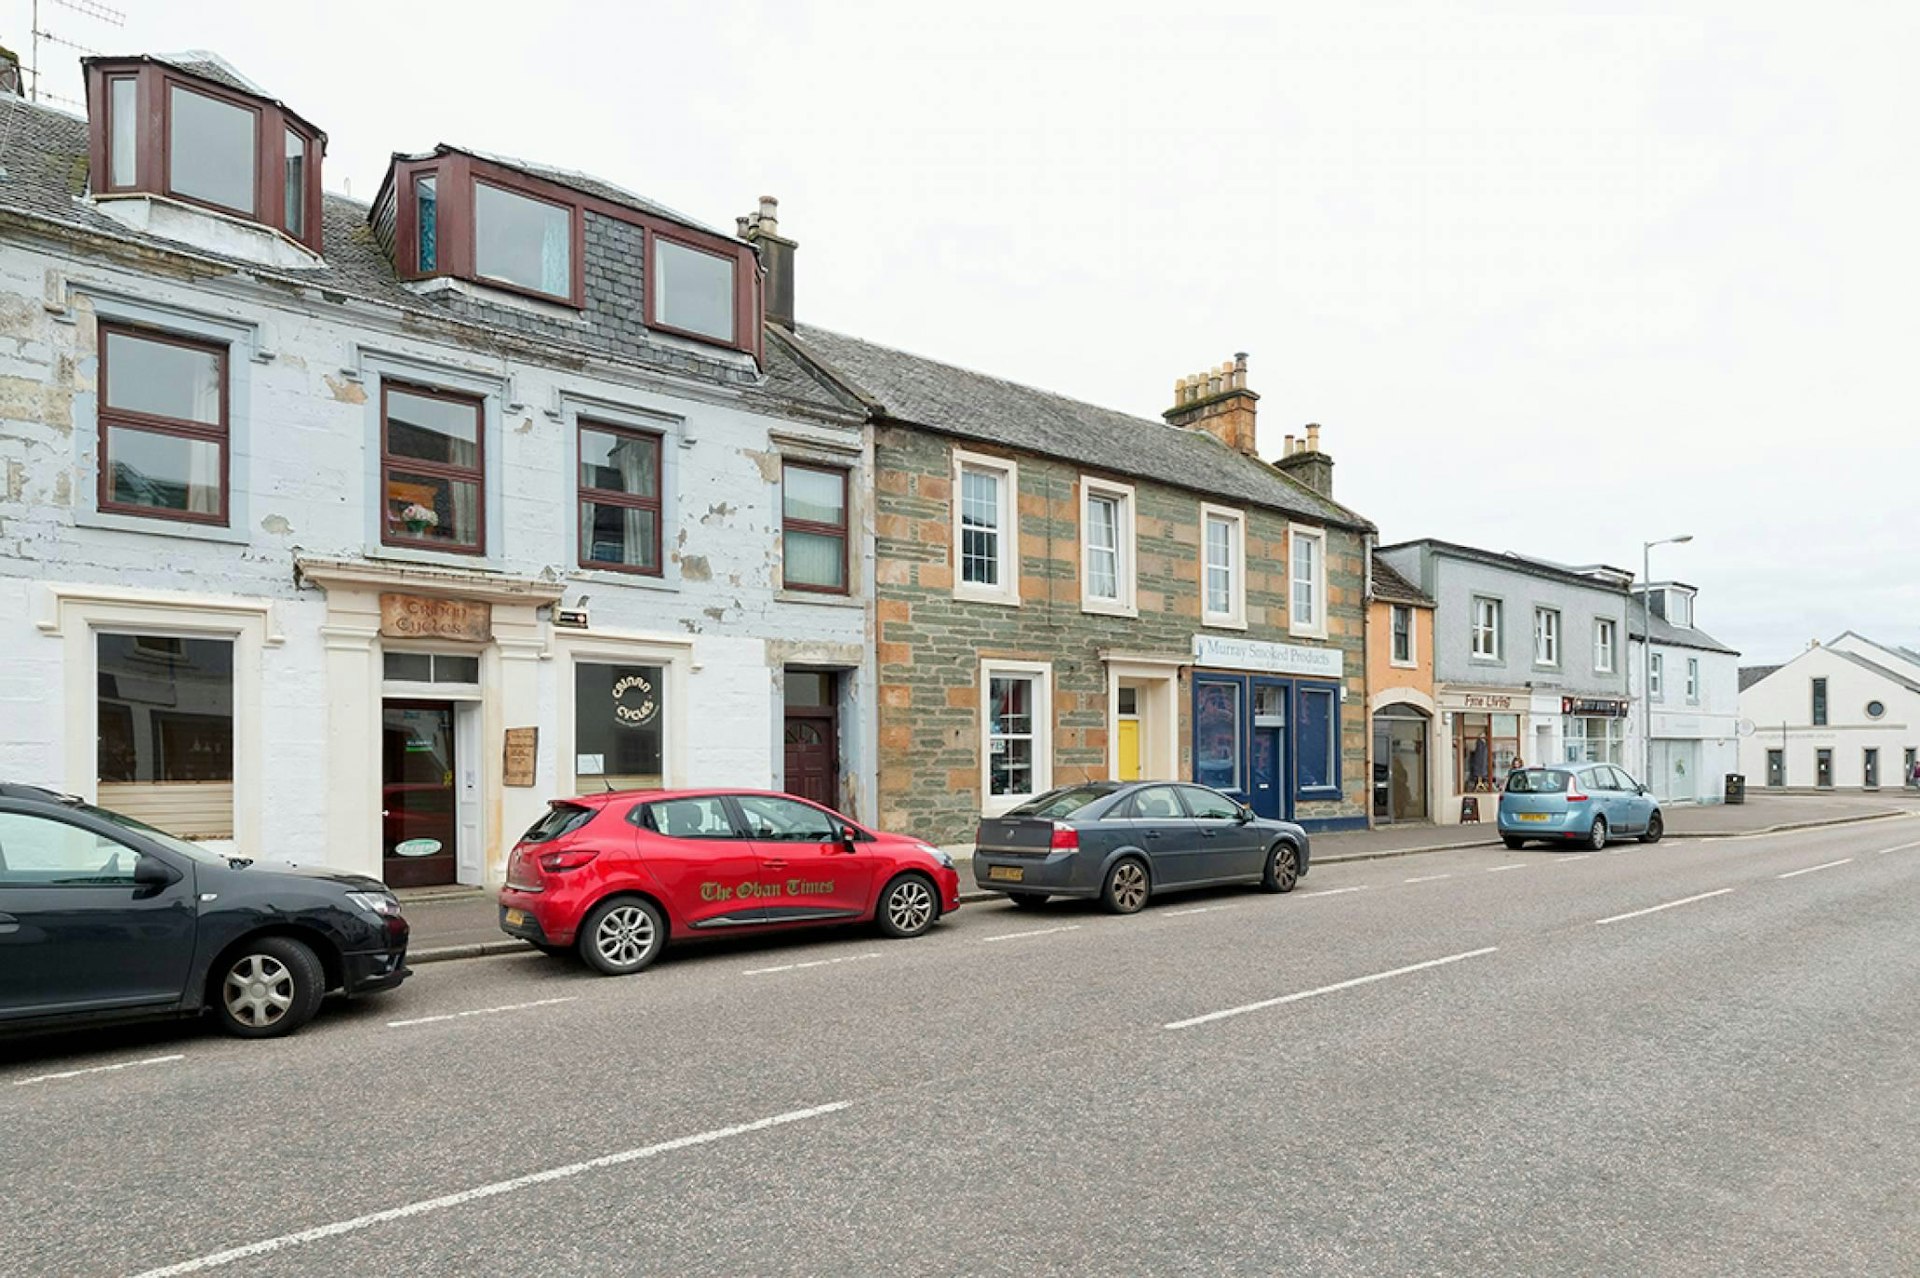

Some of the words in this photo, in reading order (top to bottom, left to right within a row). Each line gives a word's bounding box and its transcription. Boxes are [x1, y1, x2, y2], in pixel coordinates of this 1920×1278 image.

[1207, 640, 1245, 661] Murray
[1249, 643, 1288, 661] Smoked
[1291, 649, 1330, 666] Products
[700, 881, 733, 901] The
[736, 881, 781, 898] Oban
[786, 878, 835, 896] Times
